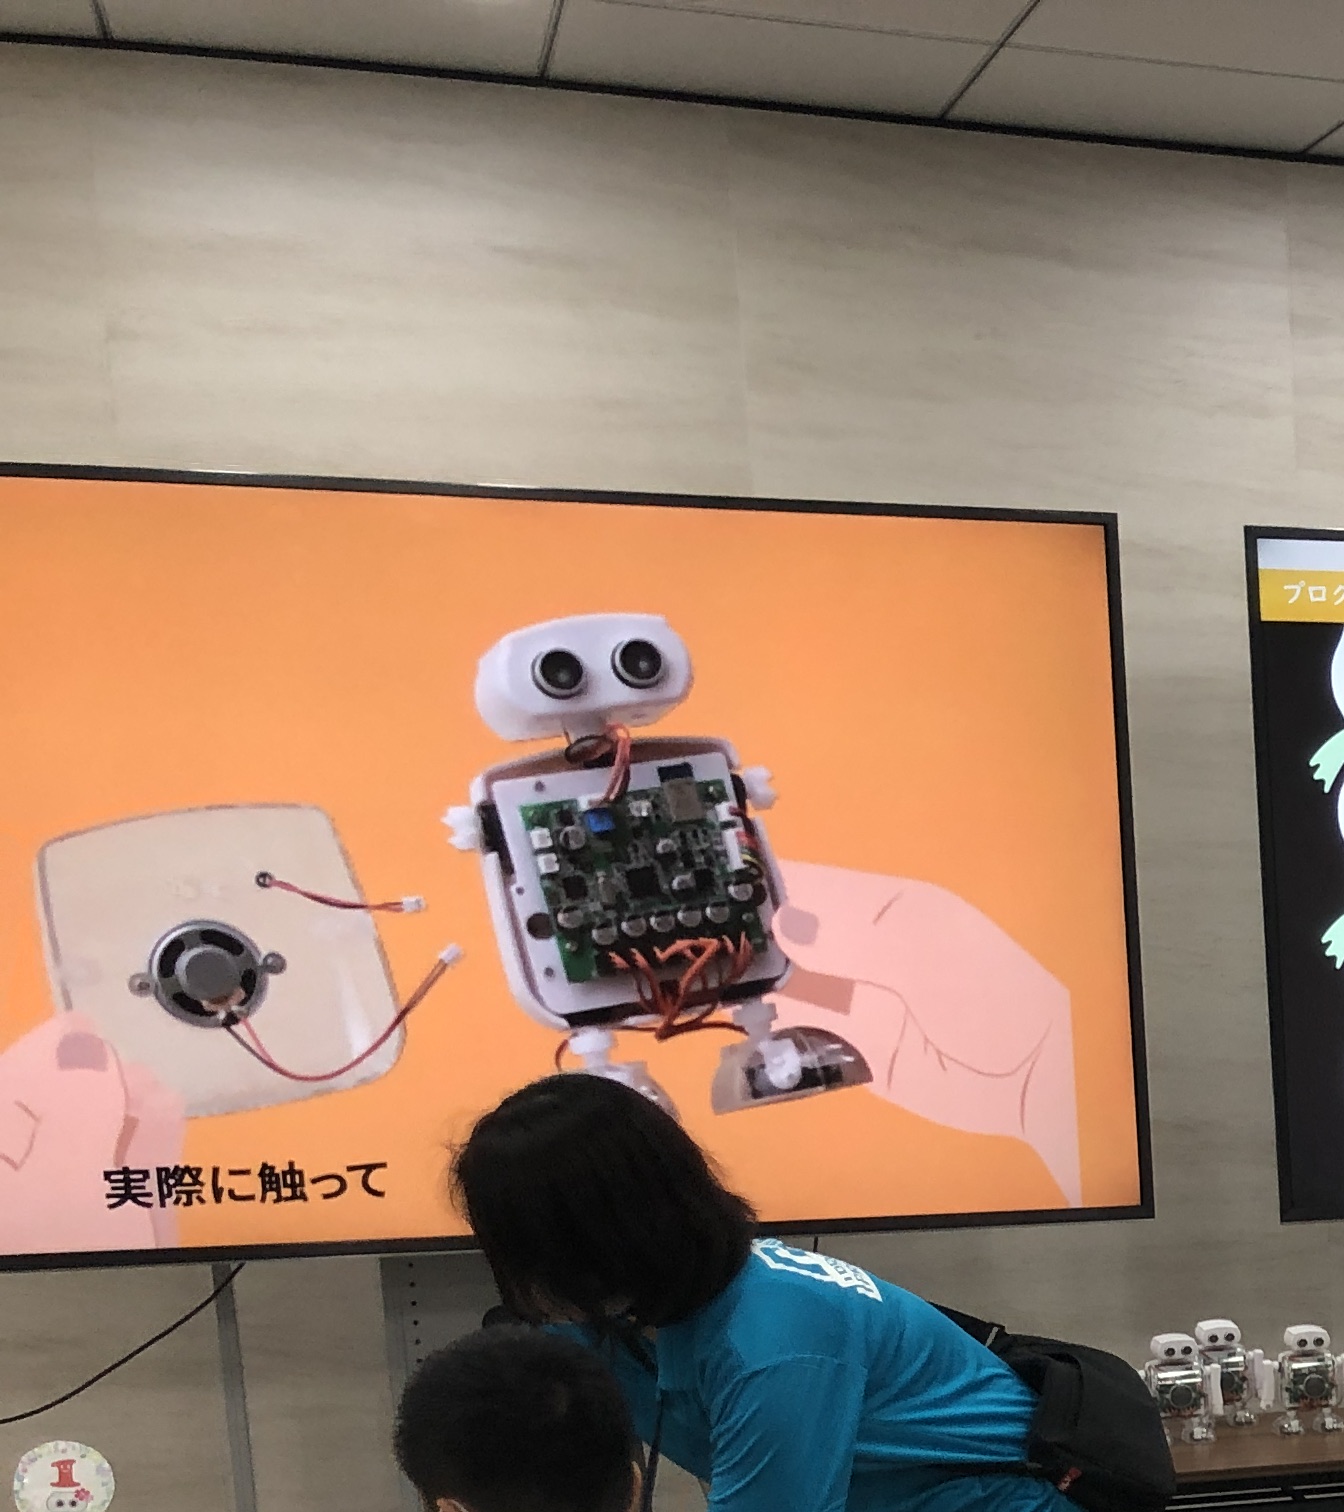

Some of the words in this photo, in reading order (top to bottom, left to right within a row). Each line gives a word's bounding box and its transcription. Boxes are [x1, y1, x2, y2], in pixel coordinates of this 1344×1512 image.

[103, 1160, 388, 1209] 実際に触って
[50, 1459, 81, 1488] 1
